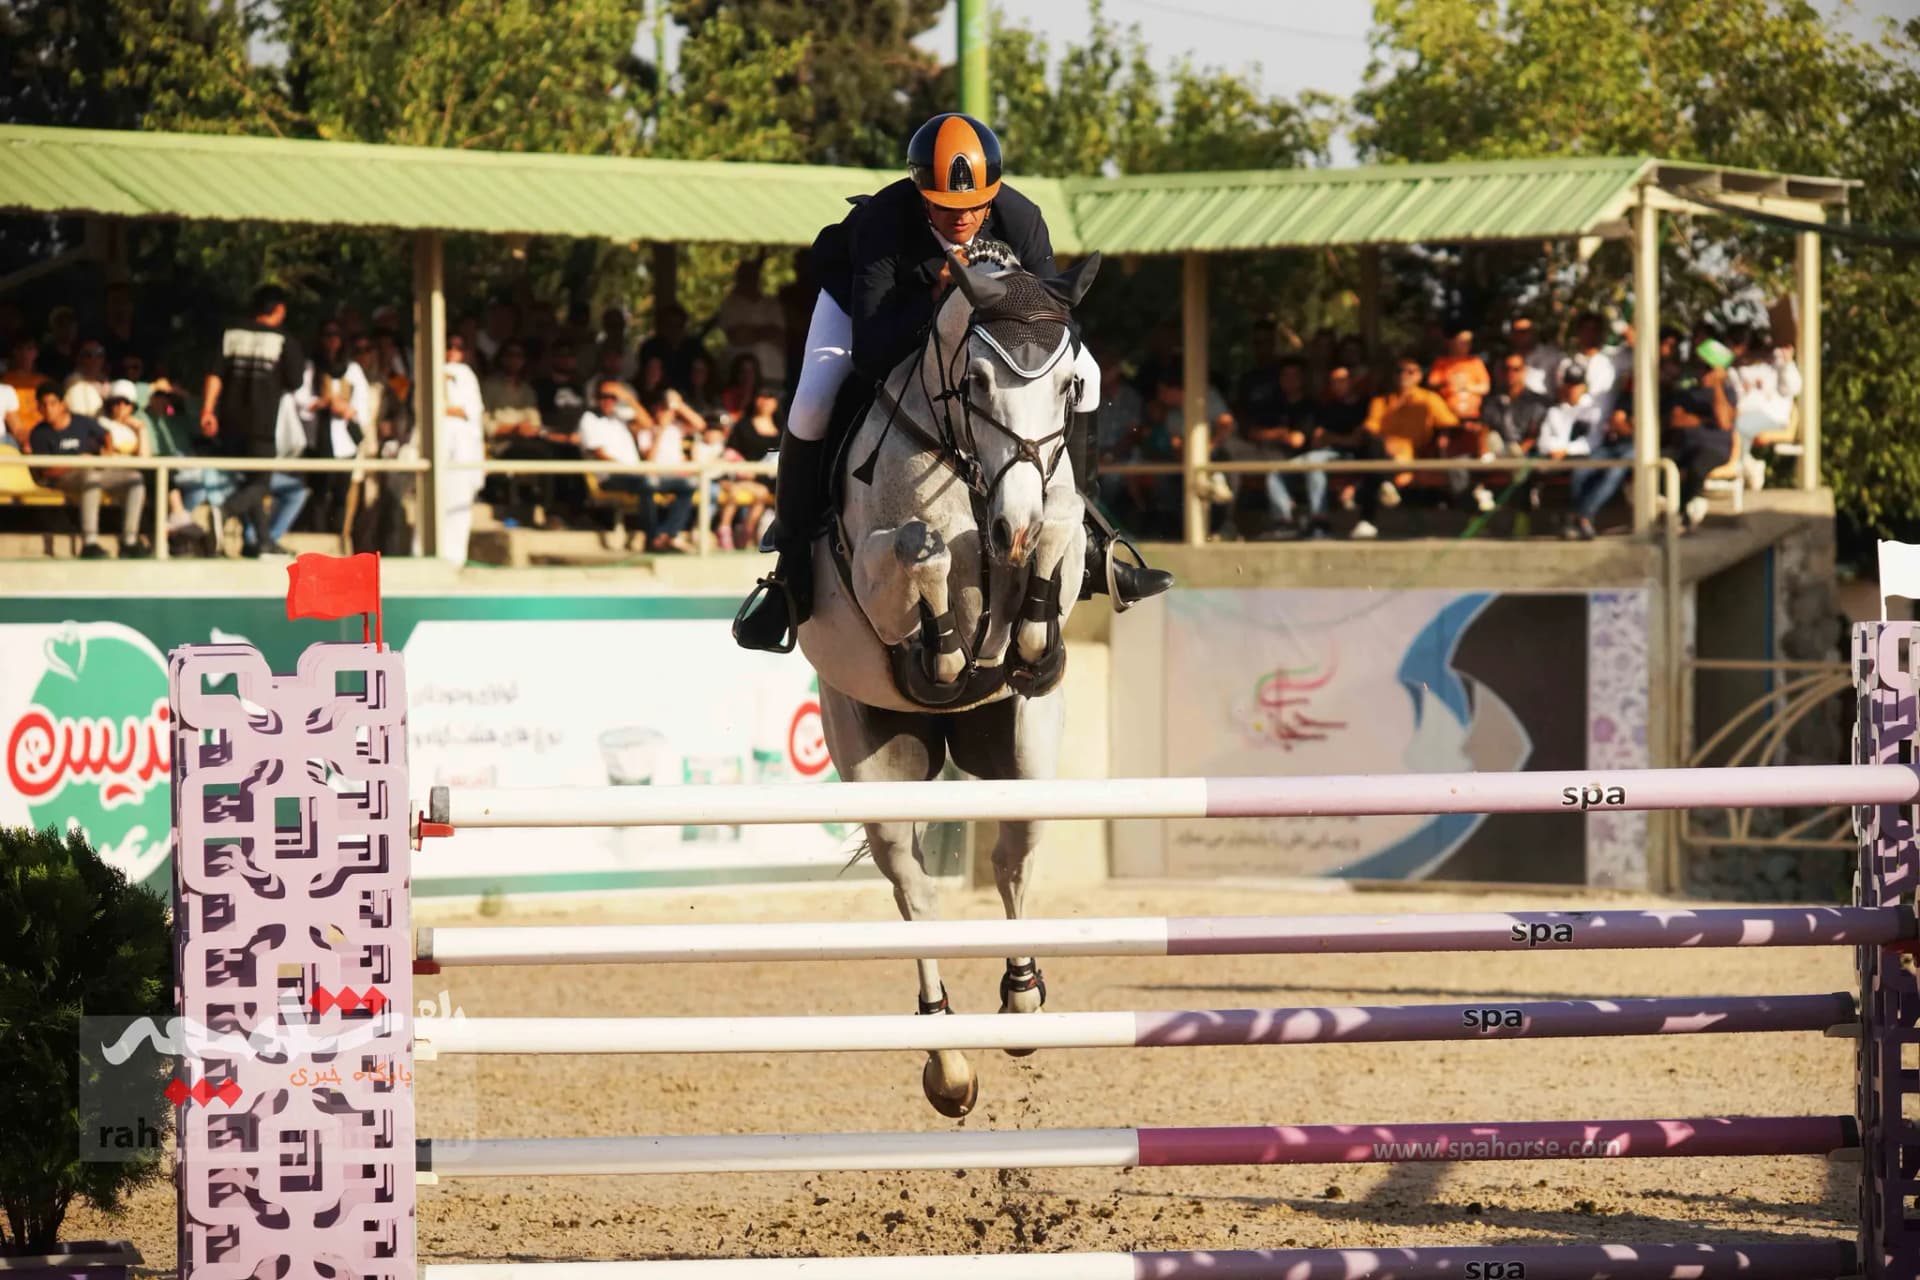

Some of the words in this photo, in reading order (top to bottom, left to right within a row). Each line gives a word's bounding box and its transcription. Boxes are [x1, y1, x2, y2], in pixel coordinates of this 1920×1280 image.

[1561, 786, 1627, 810] spa
[1511, 922, 1574, 947] spa
[1463, 1008, 1523, 1033] spa
[1373, 1134, 1620, 1160] www.spahorse.com
[1464, 1261, 1525, 1280] spa
